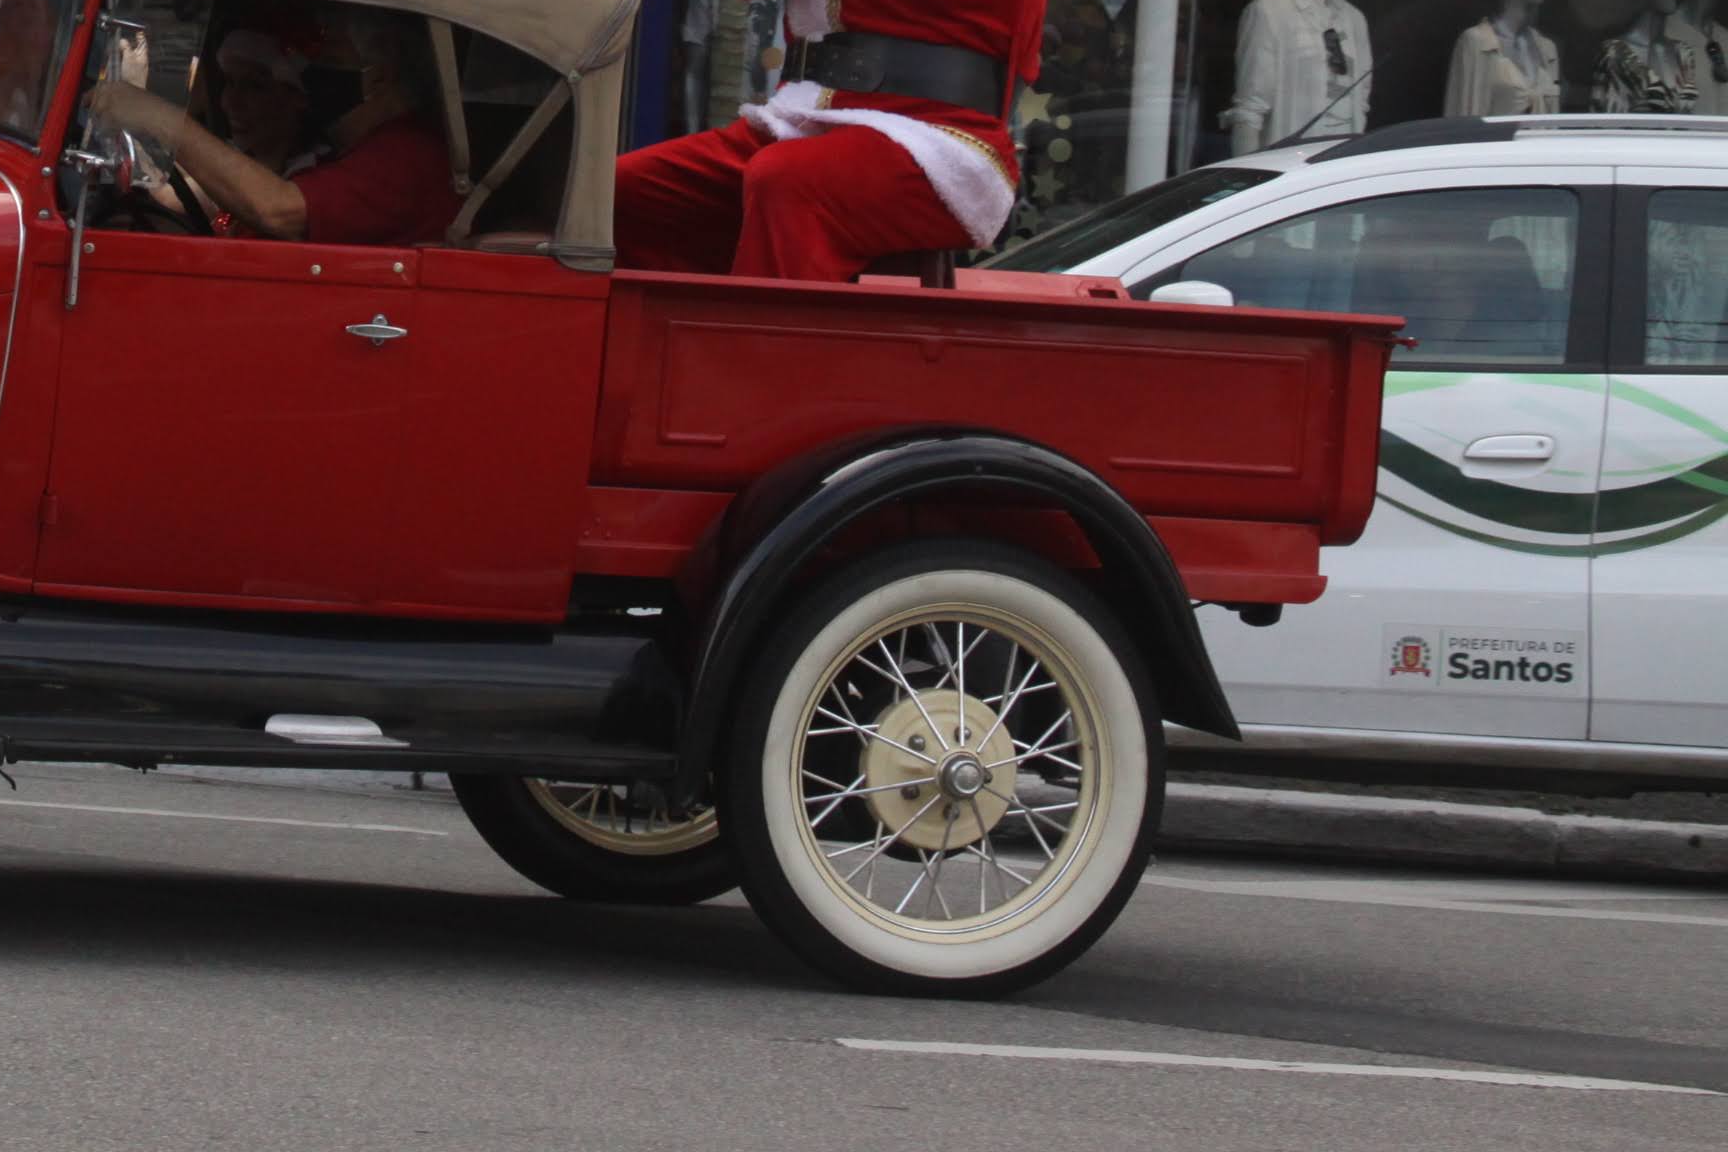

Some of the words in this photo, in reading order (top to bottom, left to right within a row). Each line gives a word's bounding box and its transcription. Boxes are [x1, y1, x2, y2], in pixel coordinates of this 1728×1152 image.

[1448, 637, 1547, 653] PREFEITURA
[1553, 641, 1576, 654] DE
[1447, 652, 1574, 684] Santos
